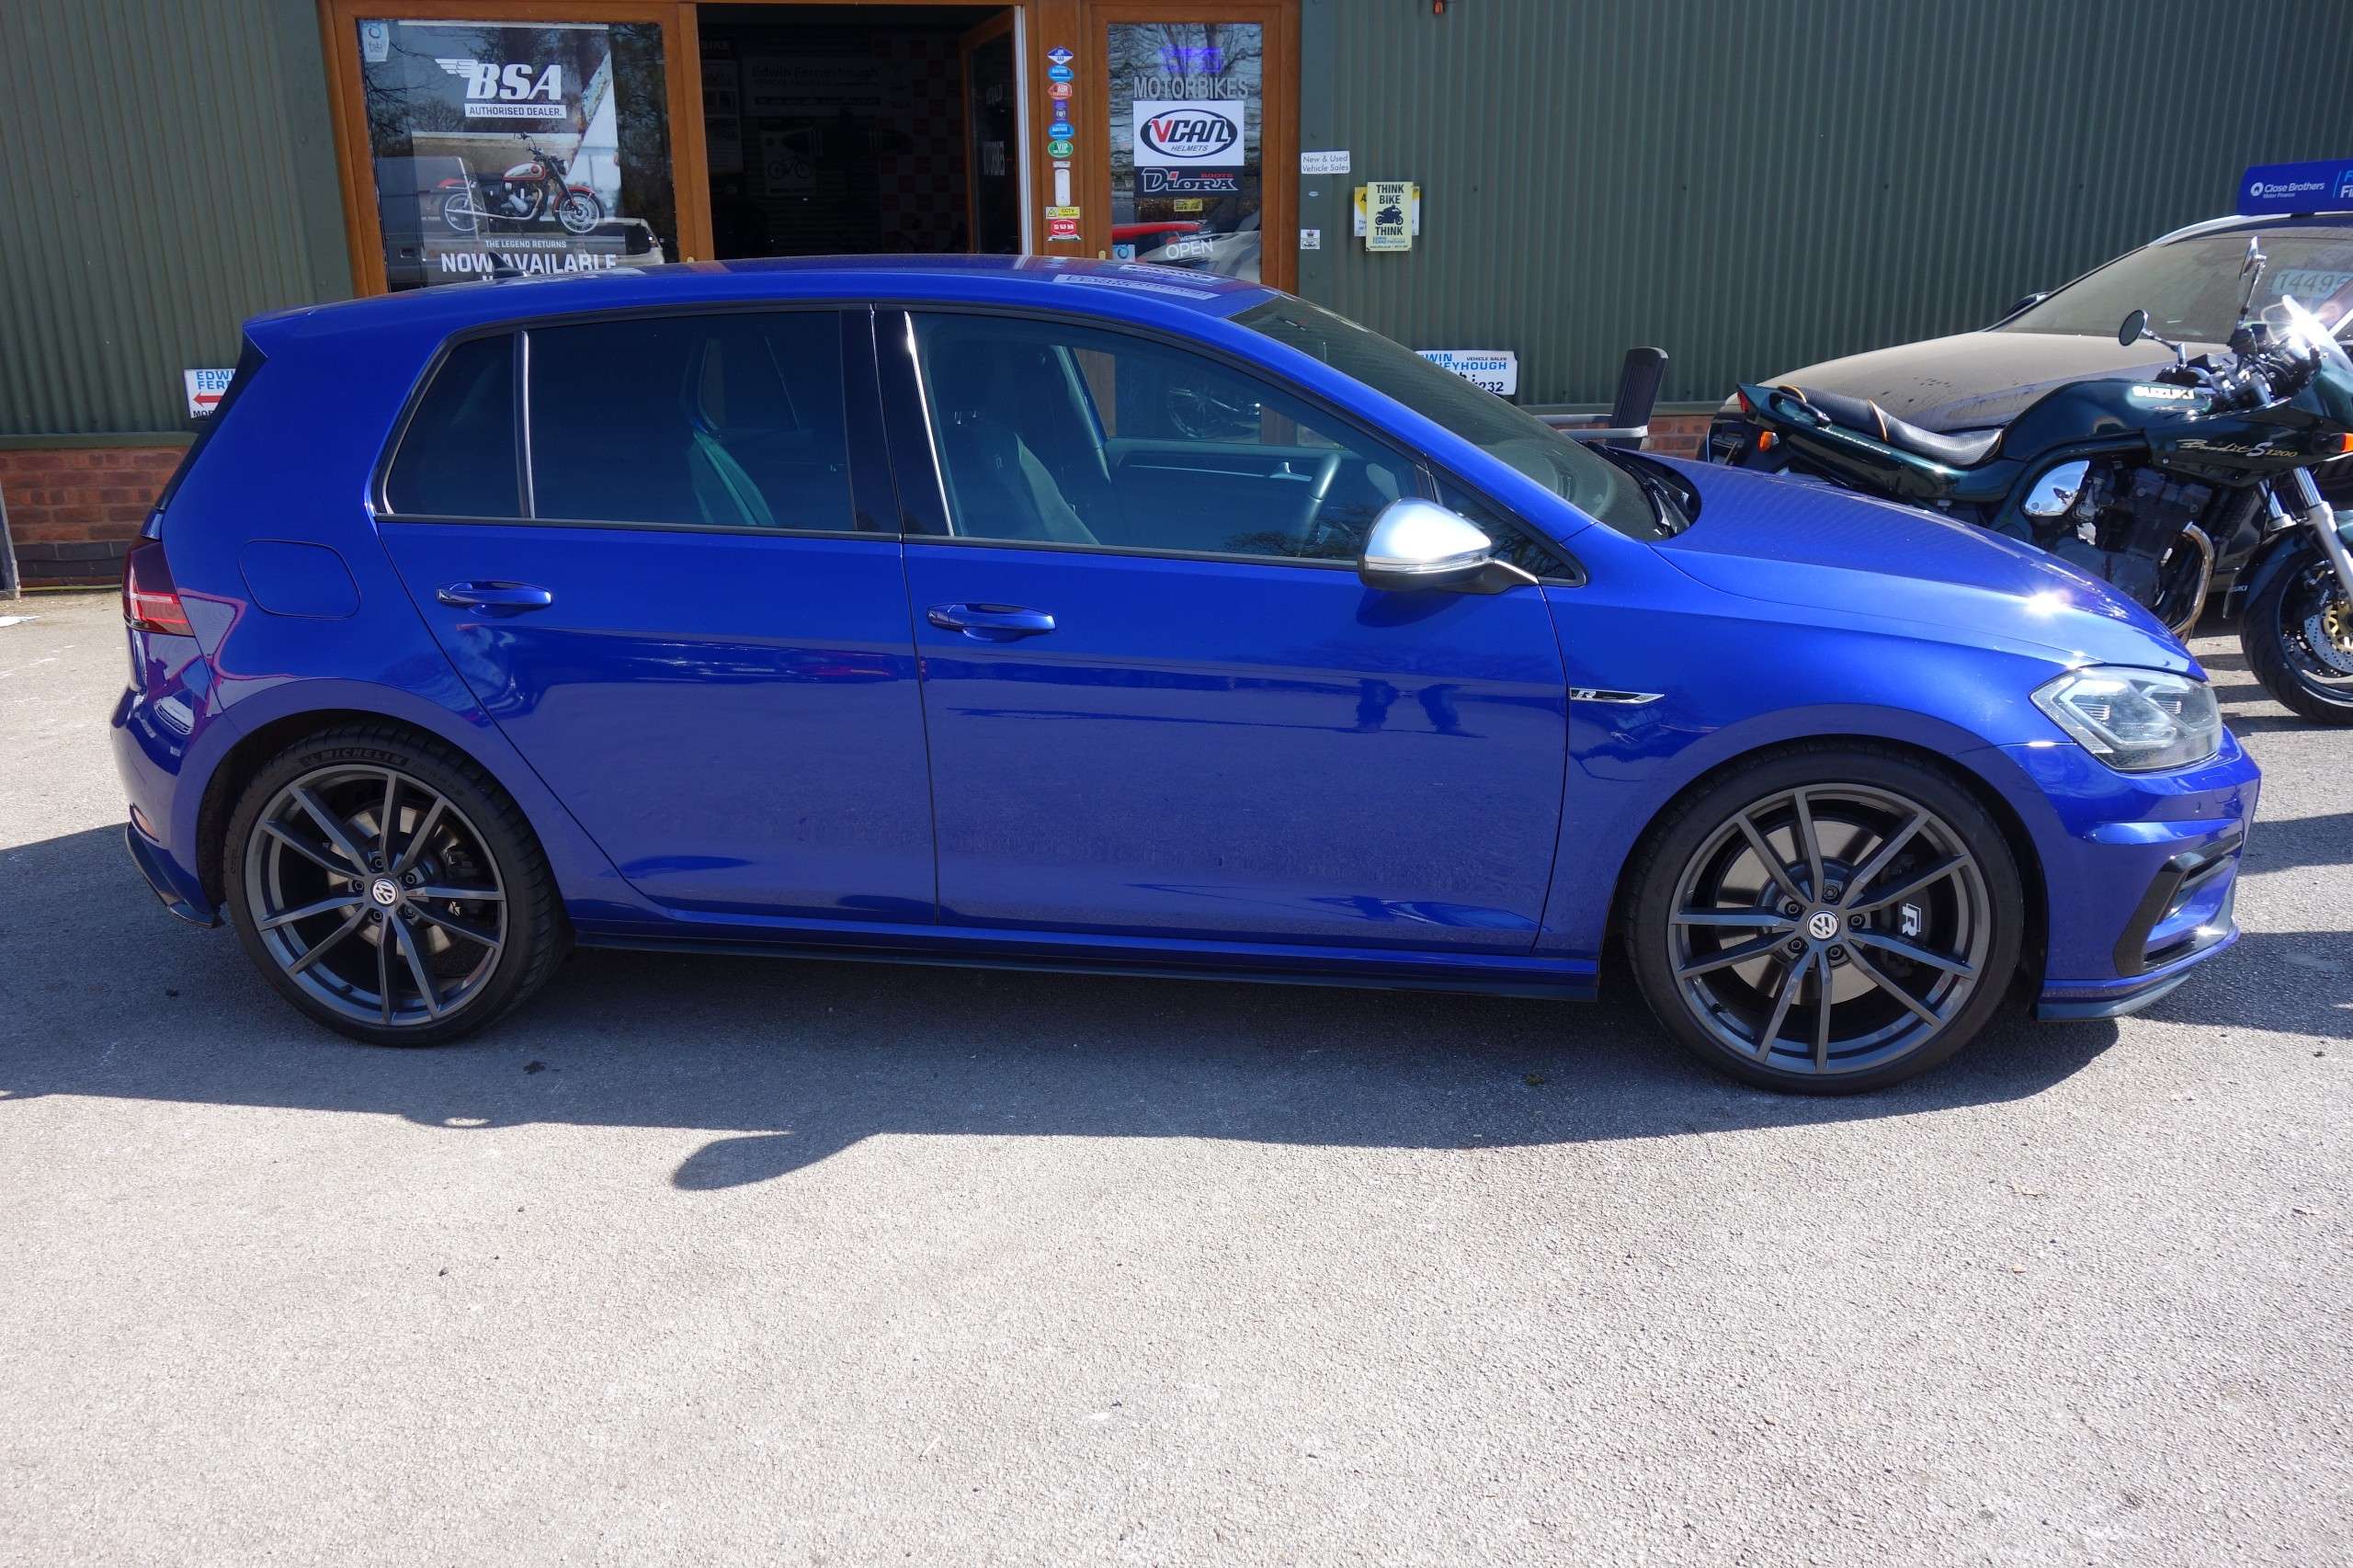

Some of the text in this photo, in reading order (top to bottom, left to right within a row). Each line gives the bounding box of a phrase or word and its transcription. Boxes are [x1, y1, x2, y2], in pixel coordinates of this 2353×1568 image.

[466, 63, 562, 100] BSA
[1133, 76, 1248, 99] MOTORBIKES
[469, 106, 525, 116] AUTHORISED
[1151, 119, 1233, 143] VCAN
[1170, 143, 1209, 152] HELMETS
[1323, 154, 1328, 163] &
[1330, 153, 1348, 163] Used
[1302, 164, 1349, 173] Vehicle Sales
[1376, 184, 1404, 194] THINK
[2264, 181, 2325, 193] Close Brothers
[1379, 194, 1402, 205] BIKE
[1375, 226, 1404, 236] THINK
[485, 240, 566, 249] THE LEGEND RETURNS
[1165, 238, 1214, 259] OPEN
[441, 253, 493, 274] NOW
[1440, 361, 1506, 370] EYHOUGH
[2131, 385, 2195, 400] SUZUKI
[2177, 438, 2251, 453] Bandit
[2265, 449, 2298, 458] 1200
[1576, 690, 1597, 699] R
[323, 747, 404, 766] MICHELIN
[1902, 903, 1922, 937] R
